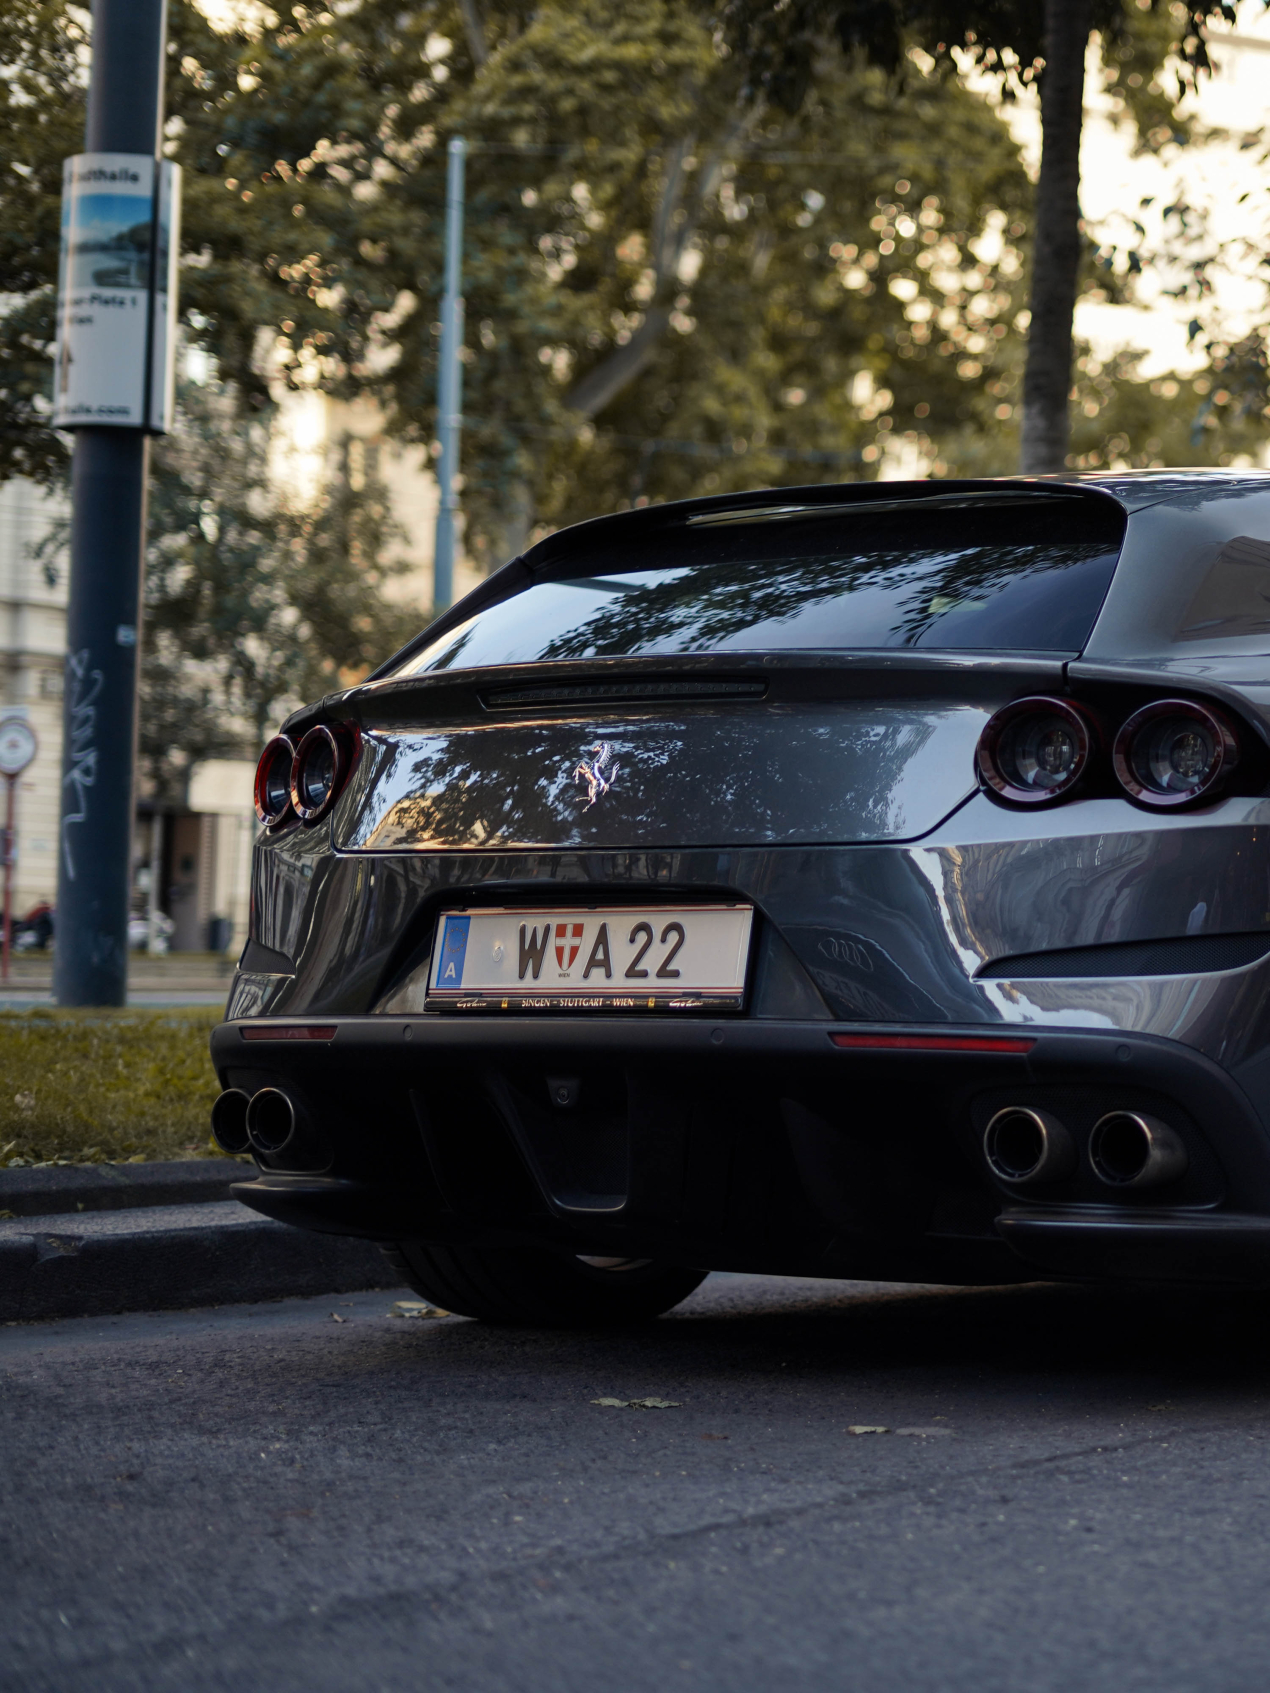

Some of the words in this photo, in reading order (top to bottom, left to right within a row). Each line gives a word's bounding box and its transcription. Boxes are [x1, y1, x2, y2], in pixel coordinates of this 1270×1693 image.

[518, 922, 551, 980] W
[444, 962, 456, 978] A
[521, 997, 550, 1007] SINGEN
[559, 997, 603, 1007] STUTTGART
[612, 997, 634, 1007] WIEN
